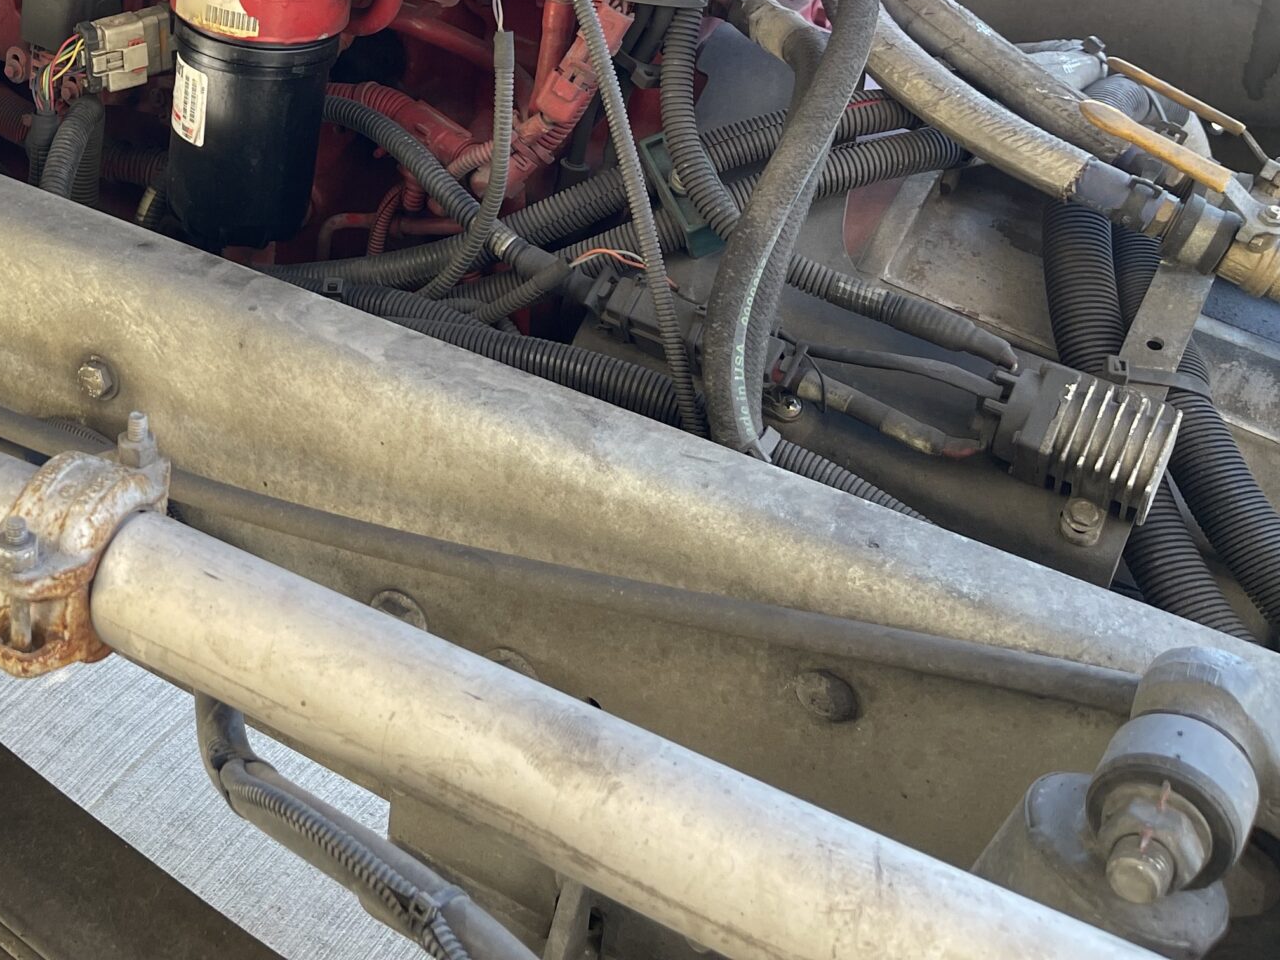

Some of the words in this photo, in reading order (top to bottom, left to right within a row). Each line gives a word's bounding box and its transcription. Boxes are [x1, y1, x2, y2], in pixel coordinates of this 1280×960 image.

[734, 344, 745, 381] USA
[736, 386, 747, 401] in
[740, 405, 757, 438] ade
